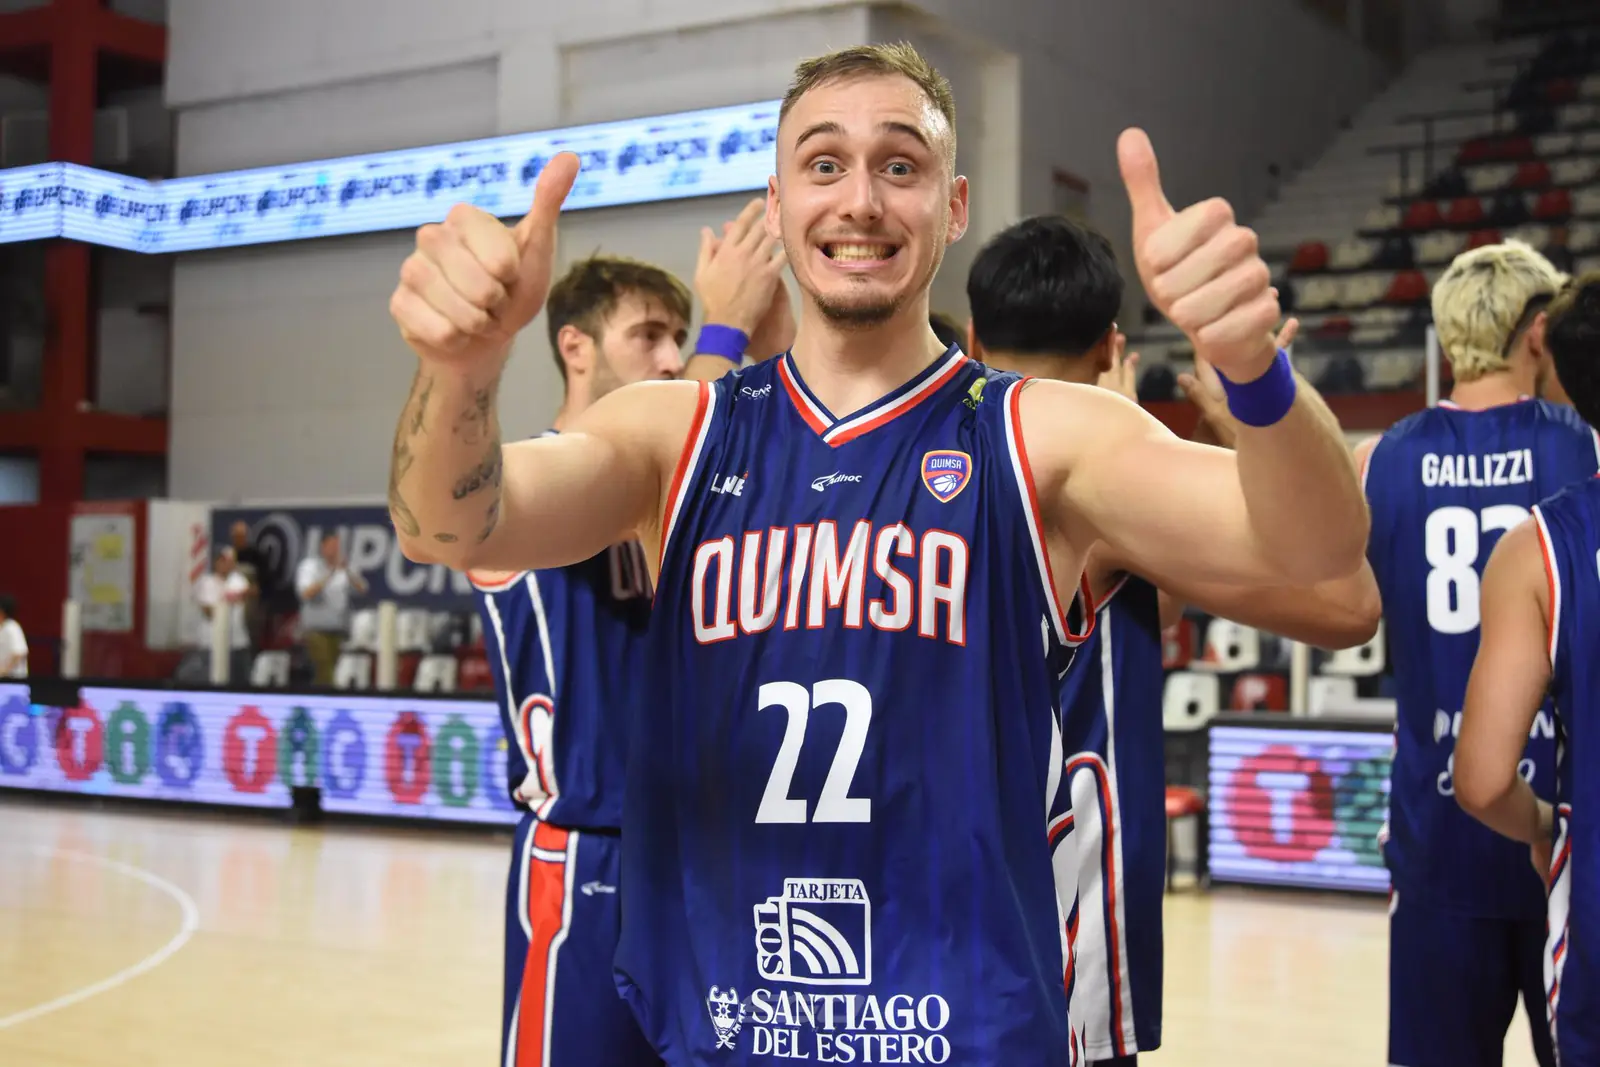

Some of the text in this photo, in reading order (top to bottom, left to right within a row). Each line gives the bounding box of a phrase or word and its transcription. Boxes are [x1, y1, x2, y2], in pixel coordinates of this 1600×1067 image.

[931, 457, 962, 470] QUIMSA
[1421, 448, 1533, 487] GALLIZZI
[691, 518, 969, 647] QUIMSA
[754, 678, 873, 824] 22
[787, 882, 865, 901] TARJETA
[758, 901, 785, 975] SOL
[752, 988, 950, 1032] SANTIAGO
[752, 1026, 952, 1064] DEL ESTERO
